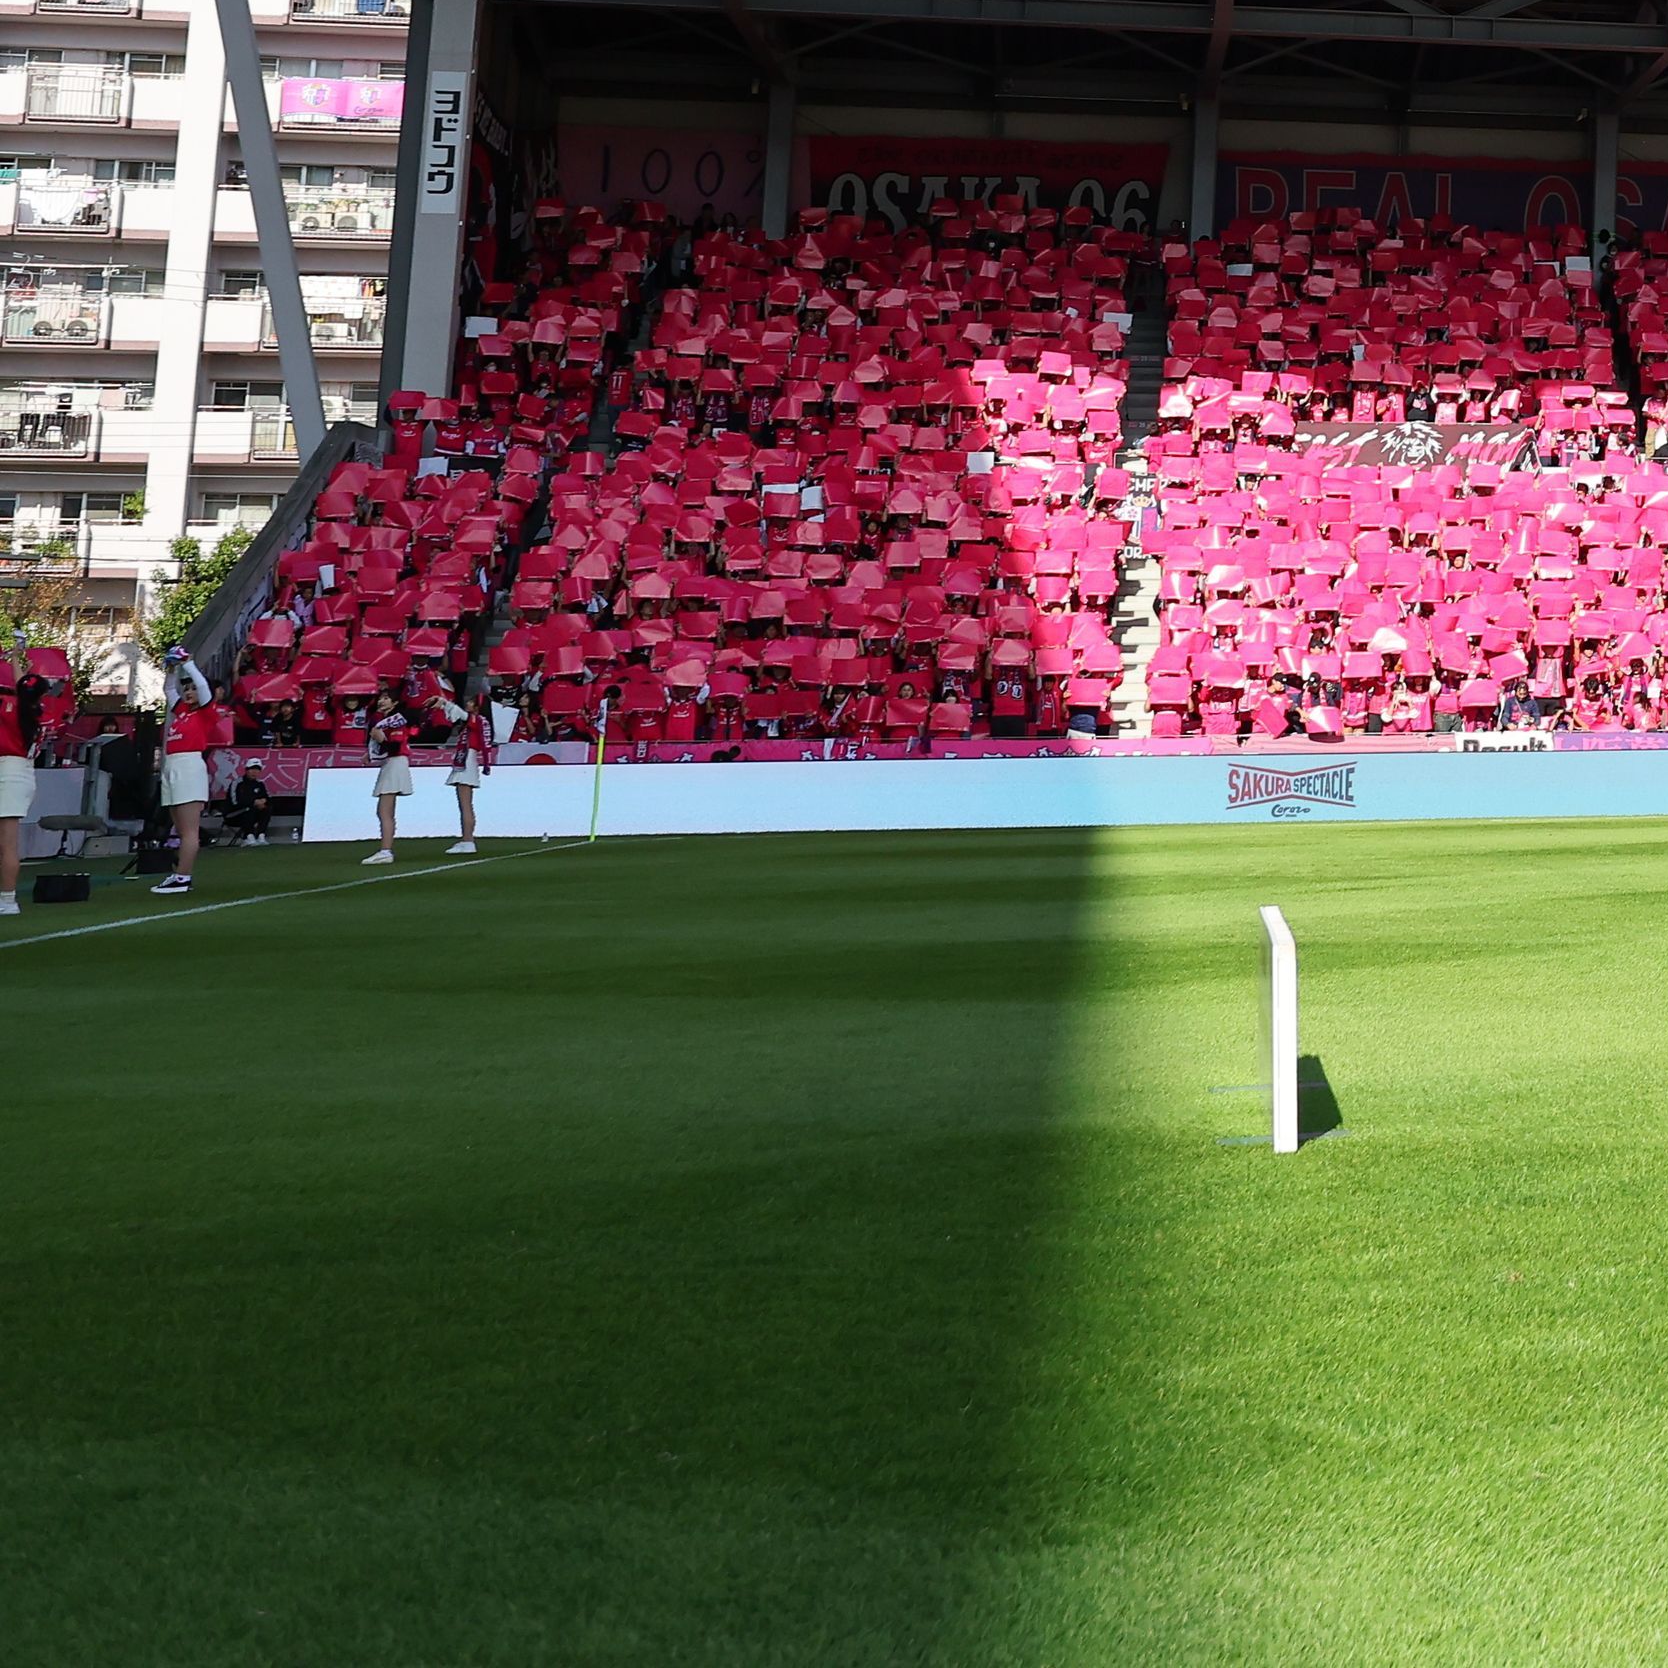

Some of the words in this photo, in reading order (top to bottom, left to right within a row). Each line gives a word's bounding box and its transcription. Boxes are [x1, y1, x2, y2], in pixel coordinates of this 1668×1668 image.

[426, 89, 461, 194] ヨドコウ
[1228, 769, 1292, 804] SAKURA
[1293, 767, 1355, 802] SPECTACLE
